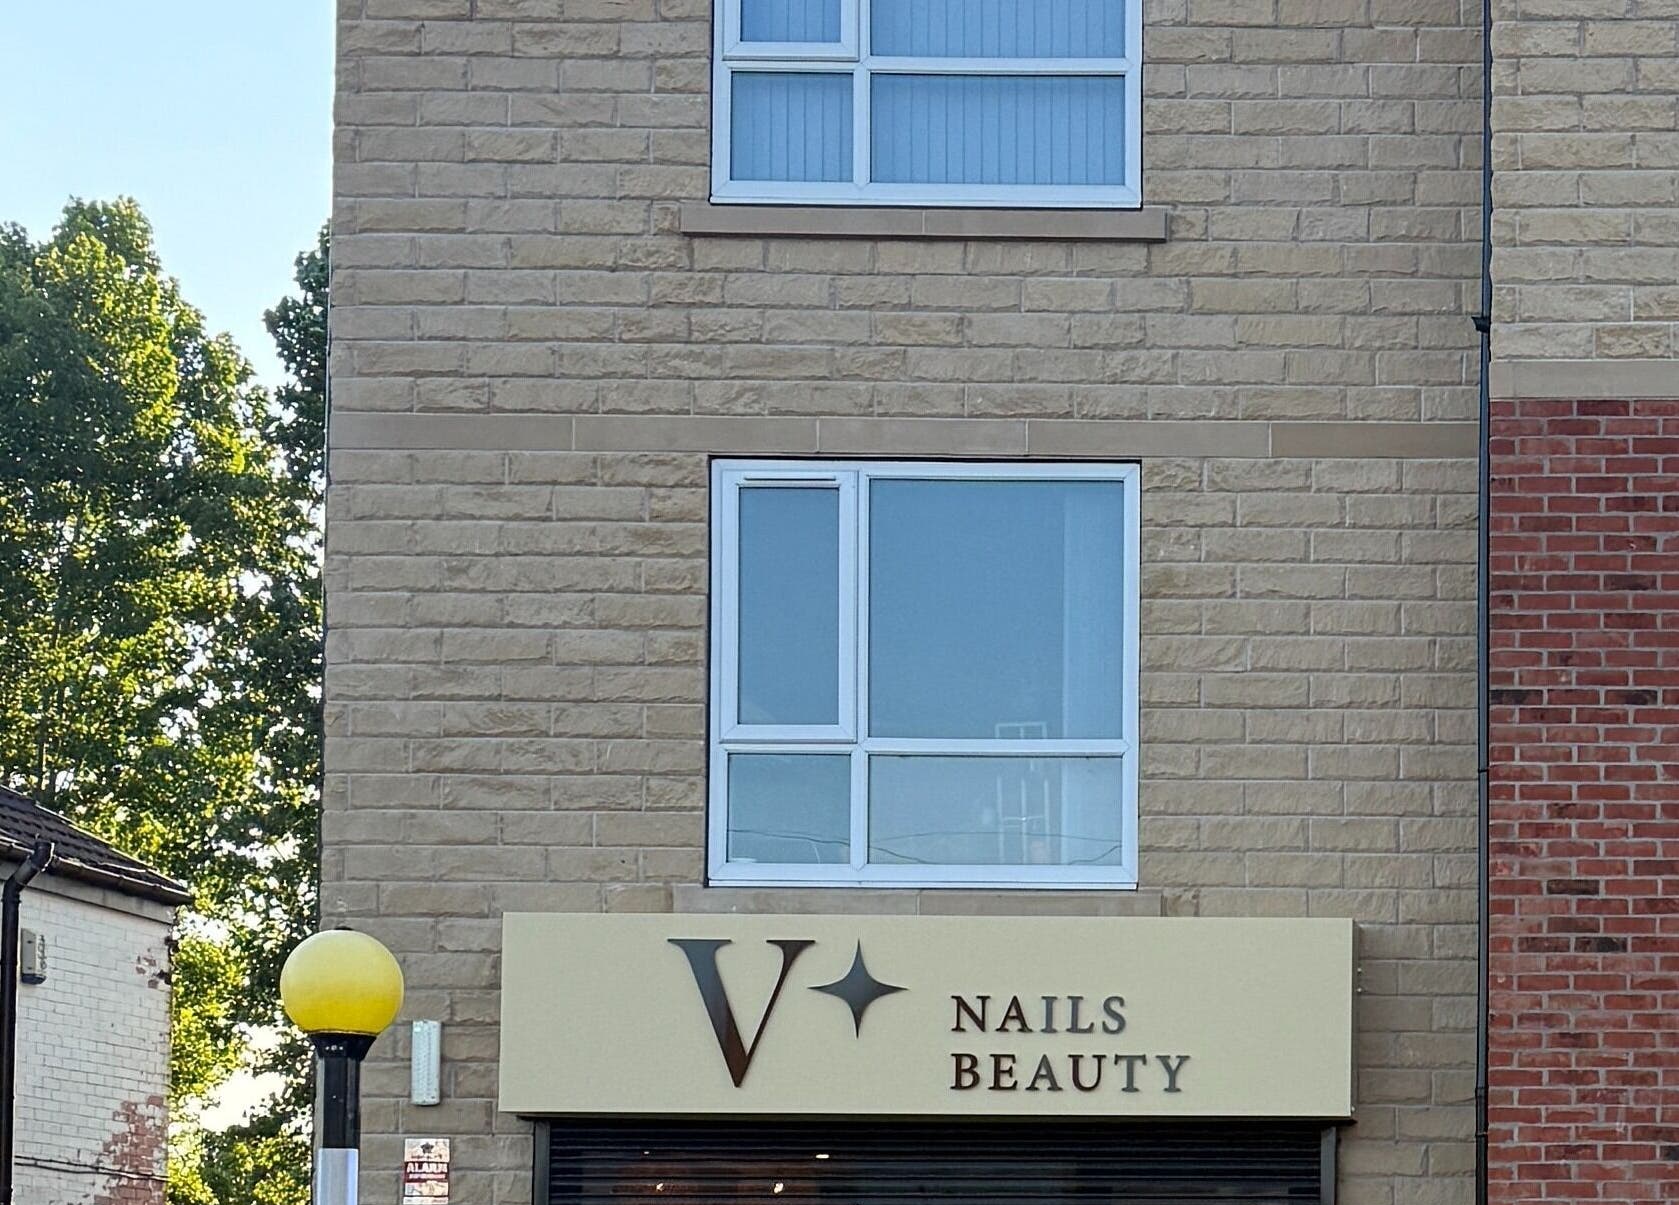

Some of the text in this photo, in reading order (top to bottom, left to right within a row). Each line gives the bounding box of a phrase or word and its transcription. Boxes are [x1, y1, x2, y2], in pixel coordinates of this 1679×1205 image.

[667, 937, 816, 1088] V
[951, 995, 1128, 1036] NAILS
[950, 1053, 1191, 1093] BEAUTY
